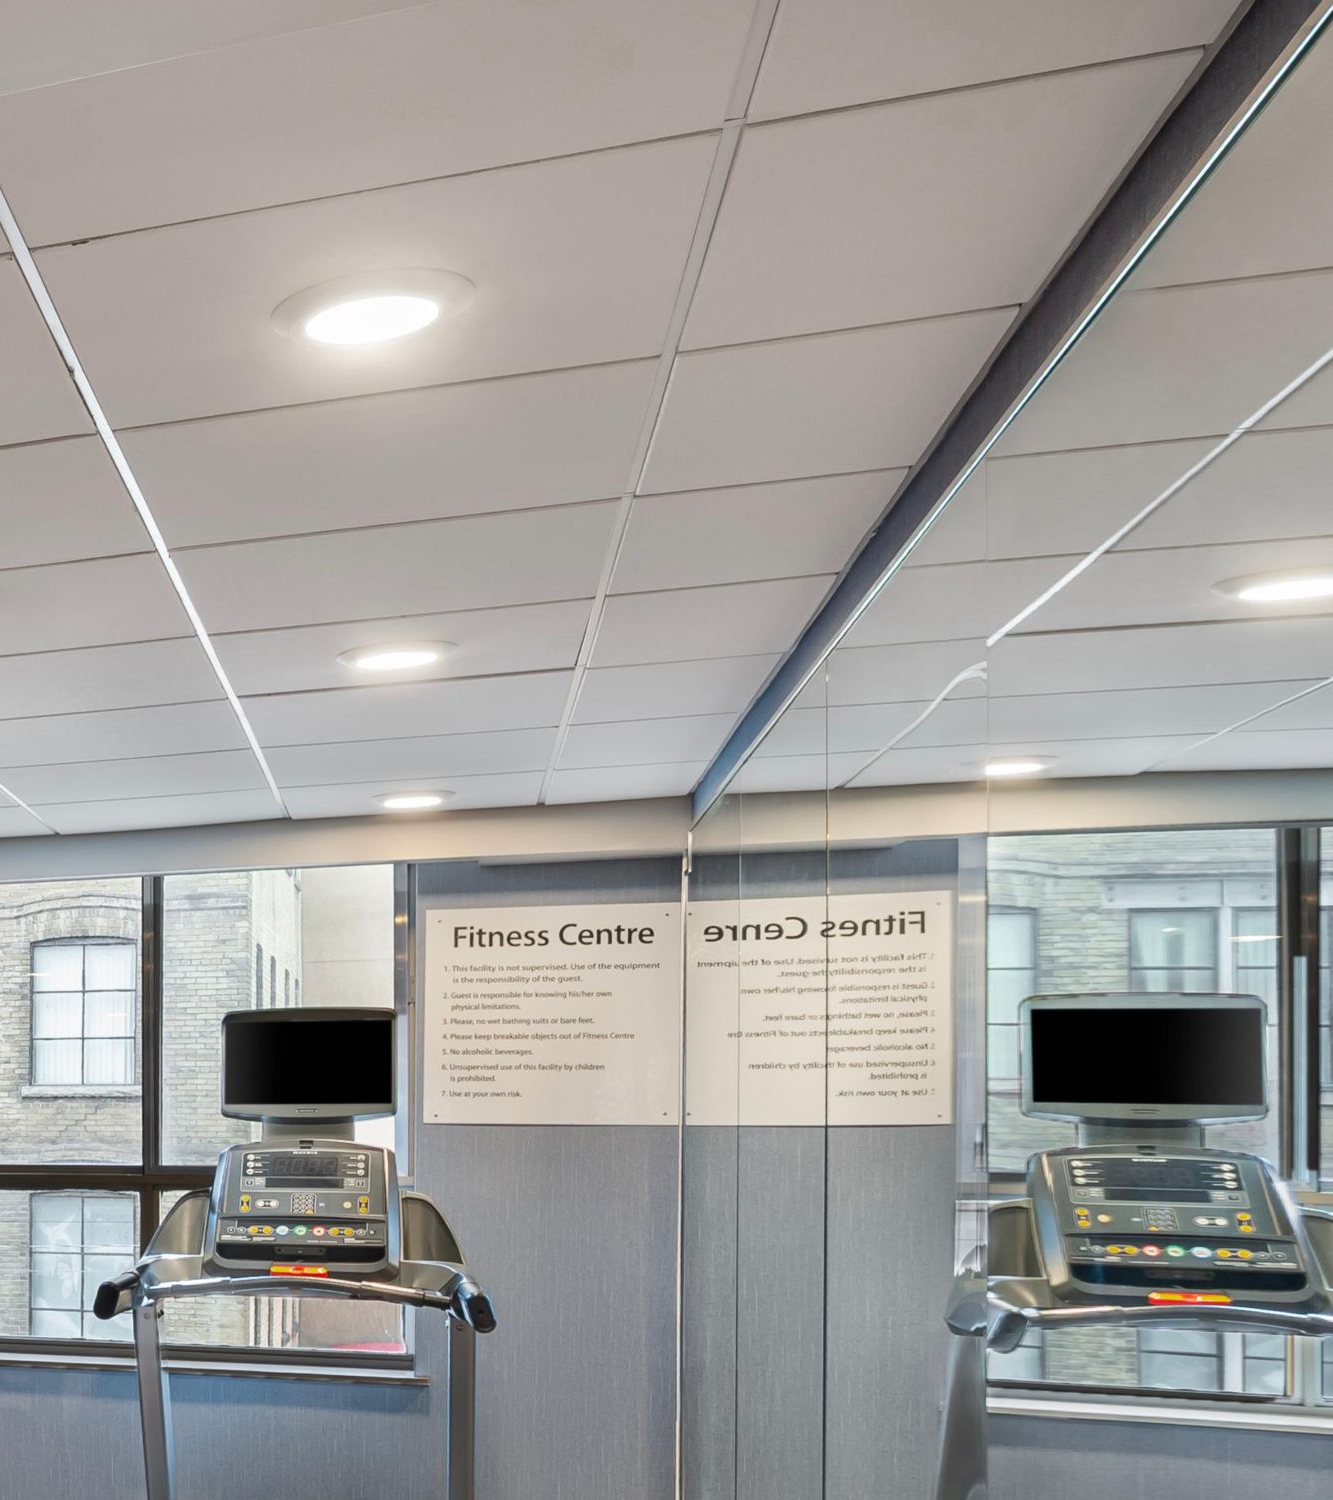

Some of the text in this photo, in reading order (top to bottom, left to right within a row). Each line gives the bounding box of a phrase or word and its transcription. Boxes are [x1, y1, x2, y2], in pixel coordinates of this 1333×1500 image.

[453, 923, 655, 948] Fitness Centre
[613, 962, 660, 970] equipment
[480, 991, 521, 999] responsible
[451, 1003, 479, 1011] physical
[502, 1017, 530, 1025] bathing
[531, 1032, 557, 1040] objects
[538, 1063, 562, 1071] facility
